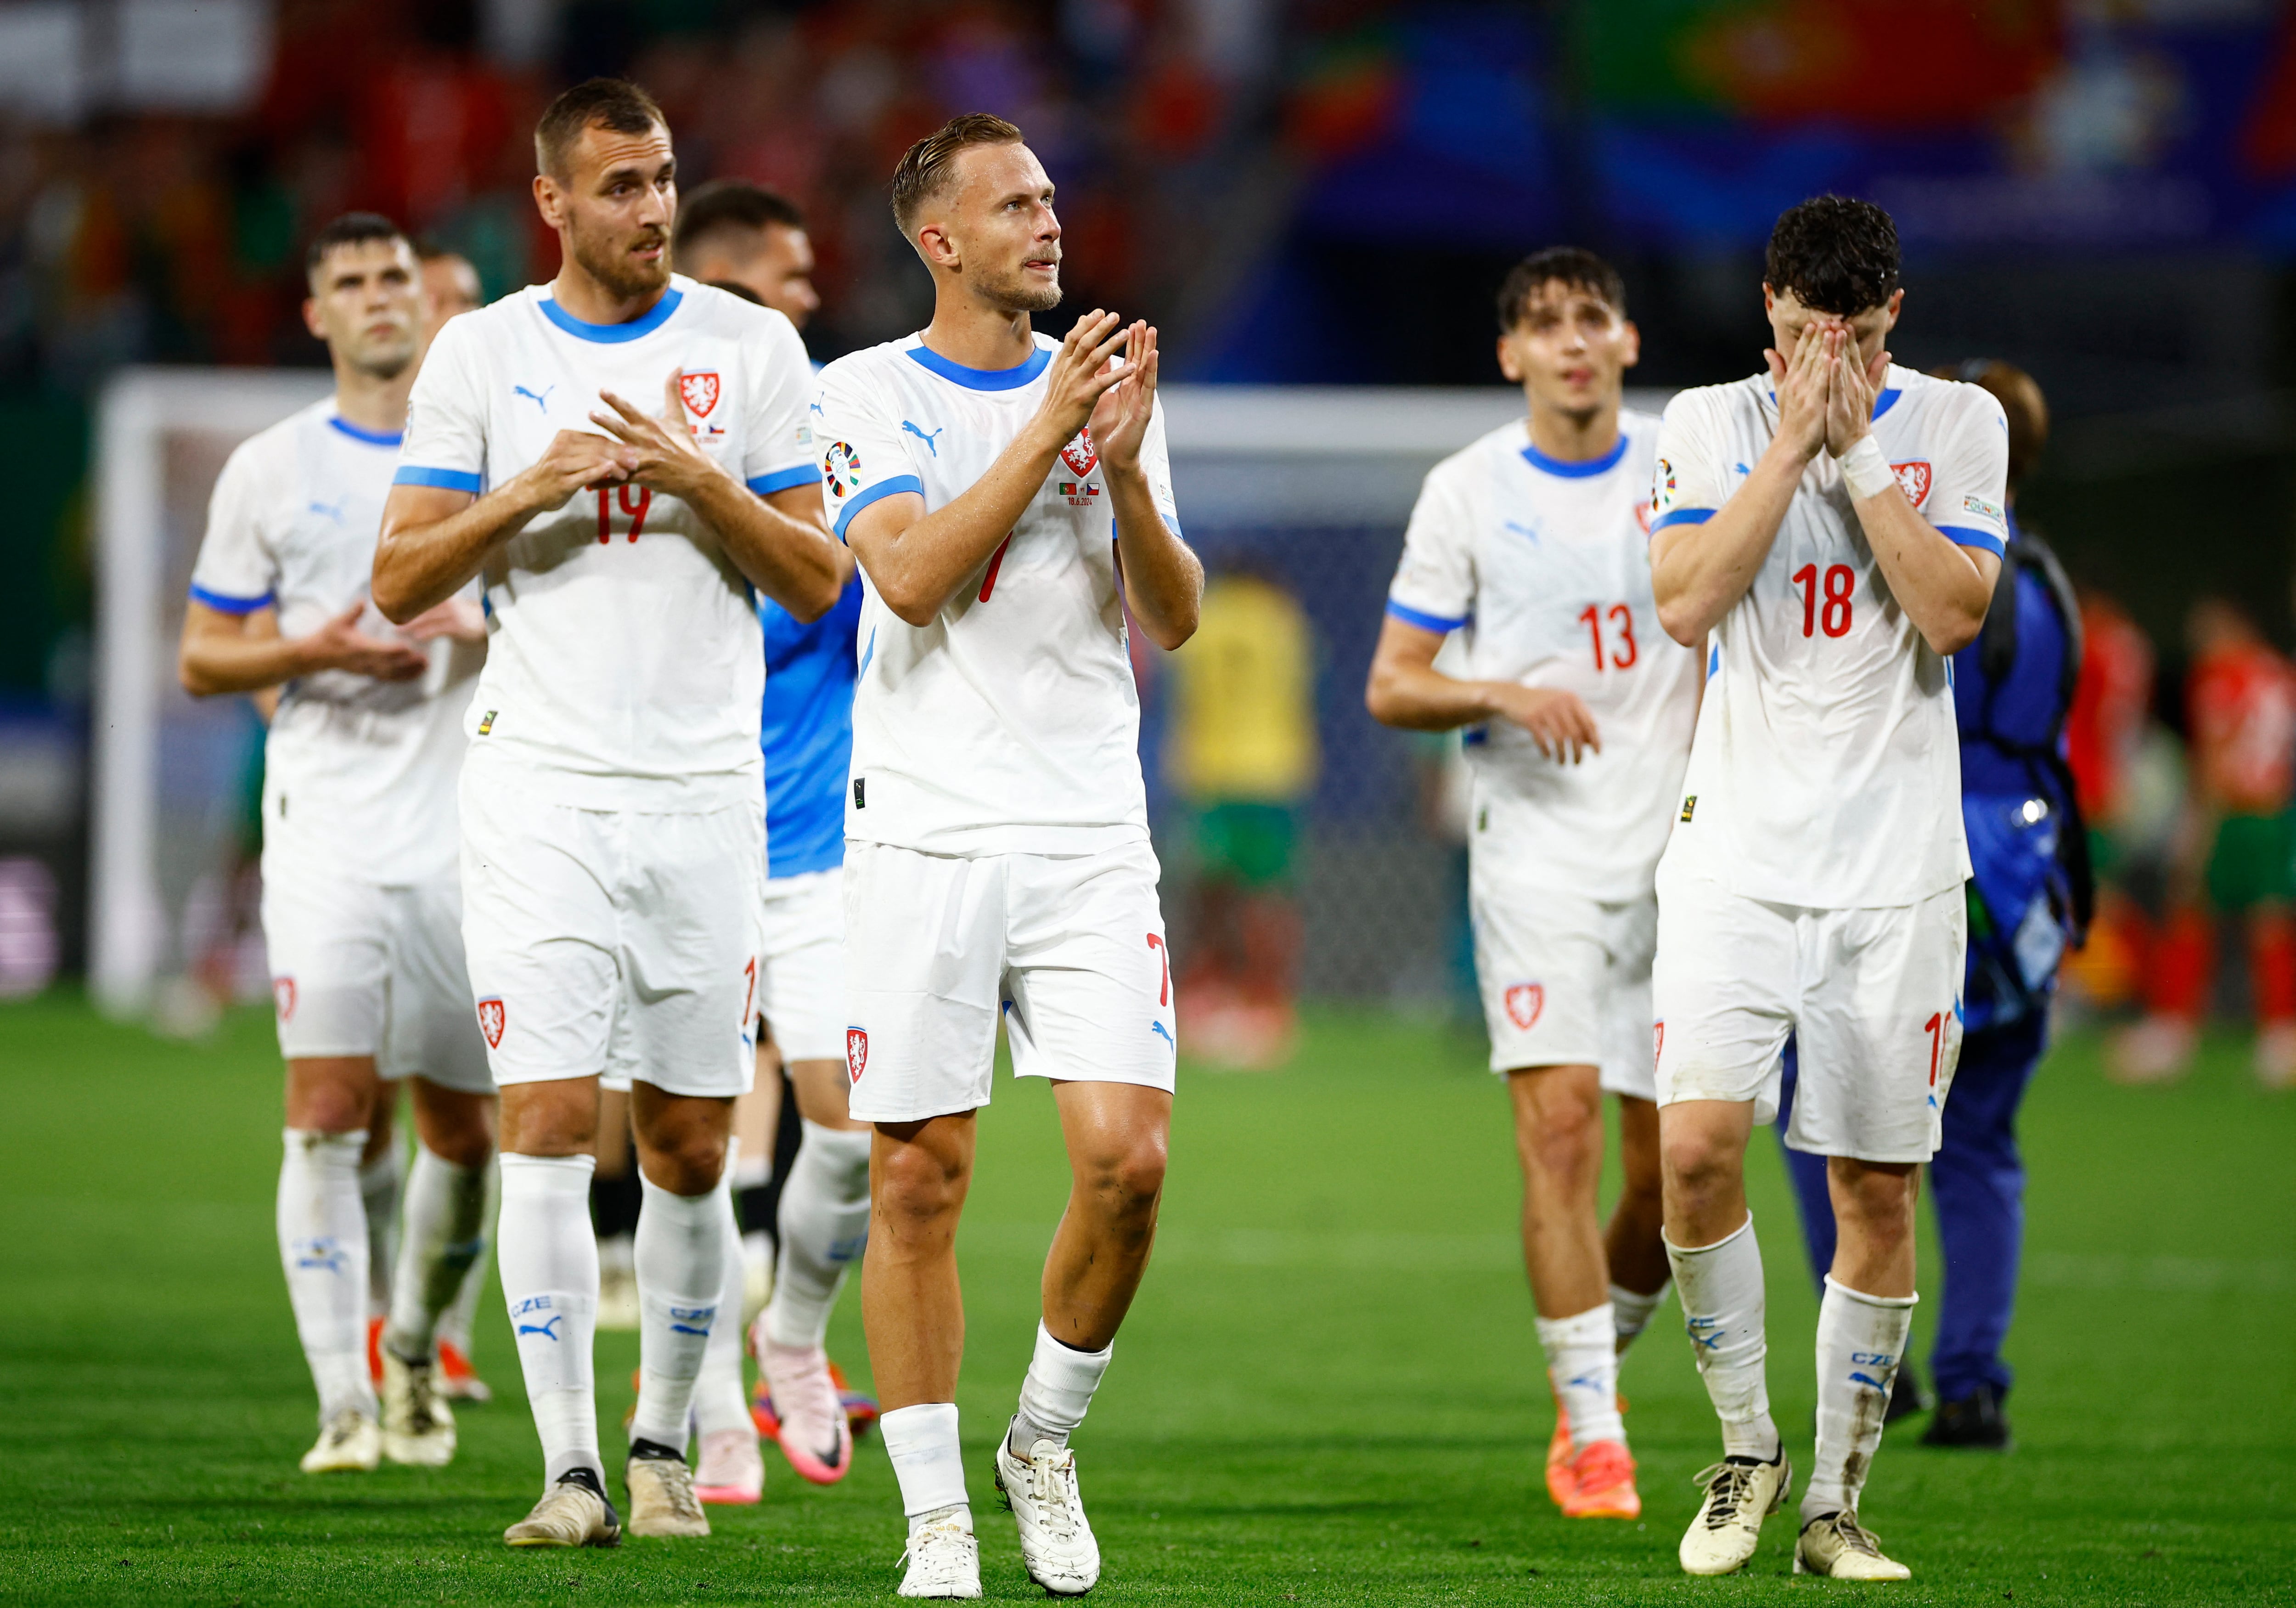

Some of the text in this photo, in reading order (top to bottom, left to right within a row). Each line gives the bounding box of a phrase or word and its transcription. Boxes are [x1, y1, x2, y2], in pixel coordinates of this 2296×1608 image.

[585, 474, 651, 545] 19
[1068, 497, 1092, 506] 18.6.2024
[1793, 563, 1855, 638] 18
[1579, 604, 1636, 671] 13
[1147, 932, 1168, 1007] 7
[1925, 1011, 1951, 1087] 1
[511, 1296, 551, 1318] CZE
[1851, 1352, 1896, 1368] CZE
